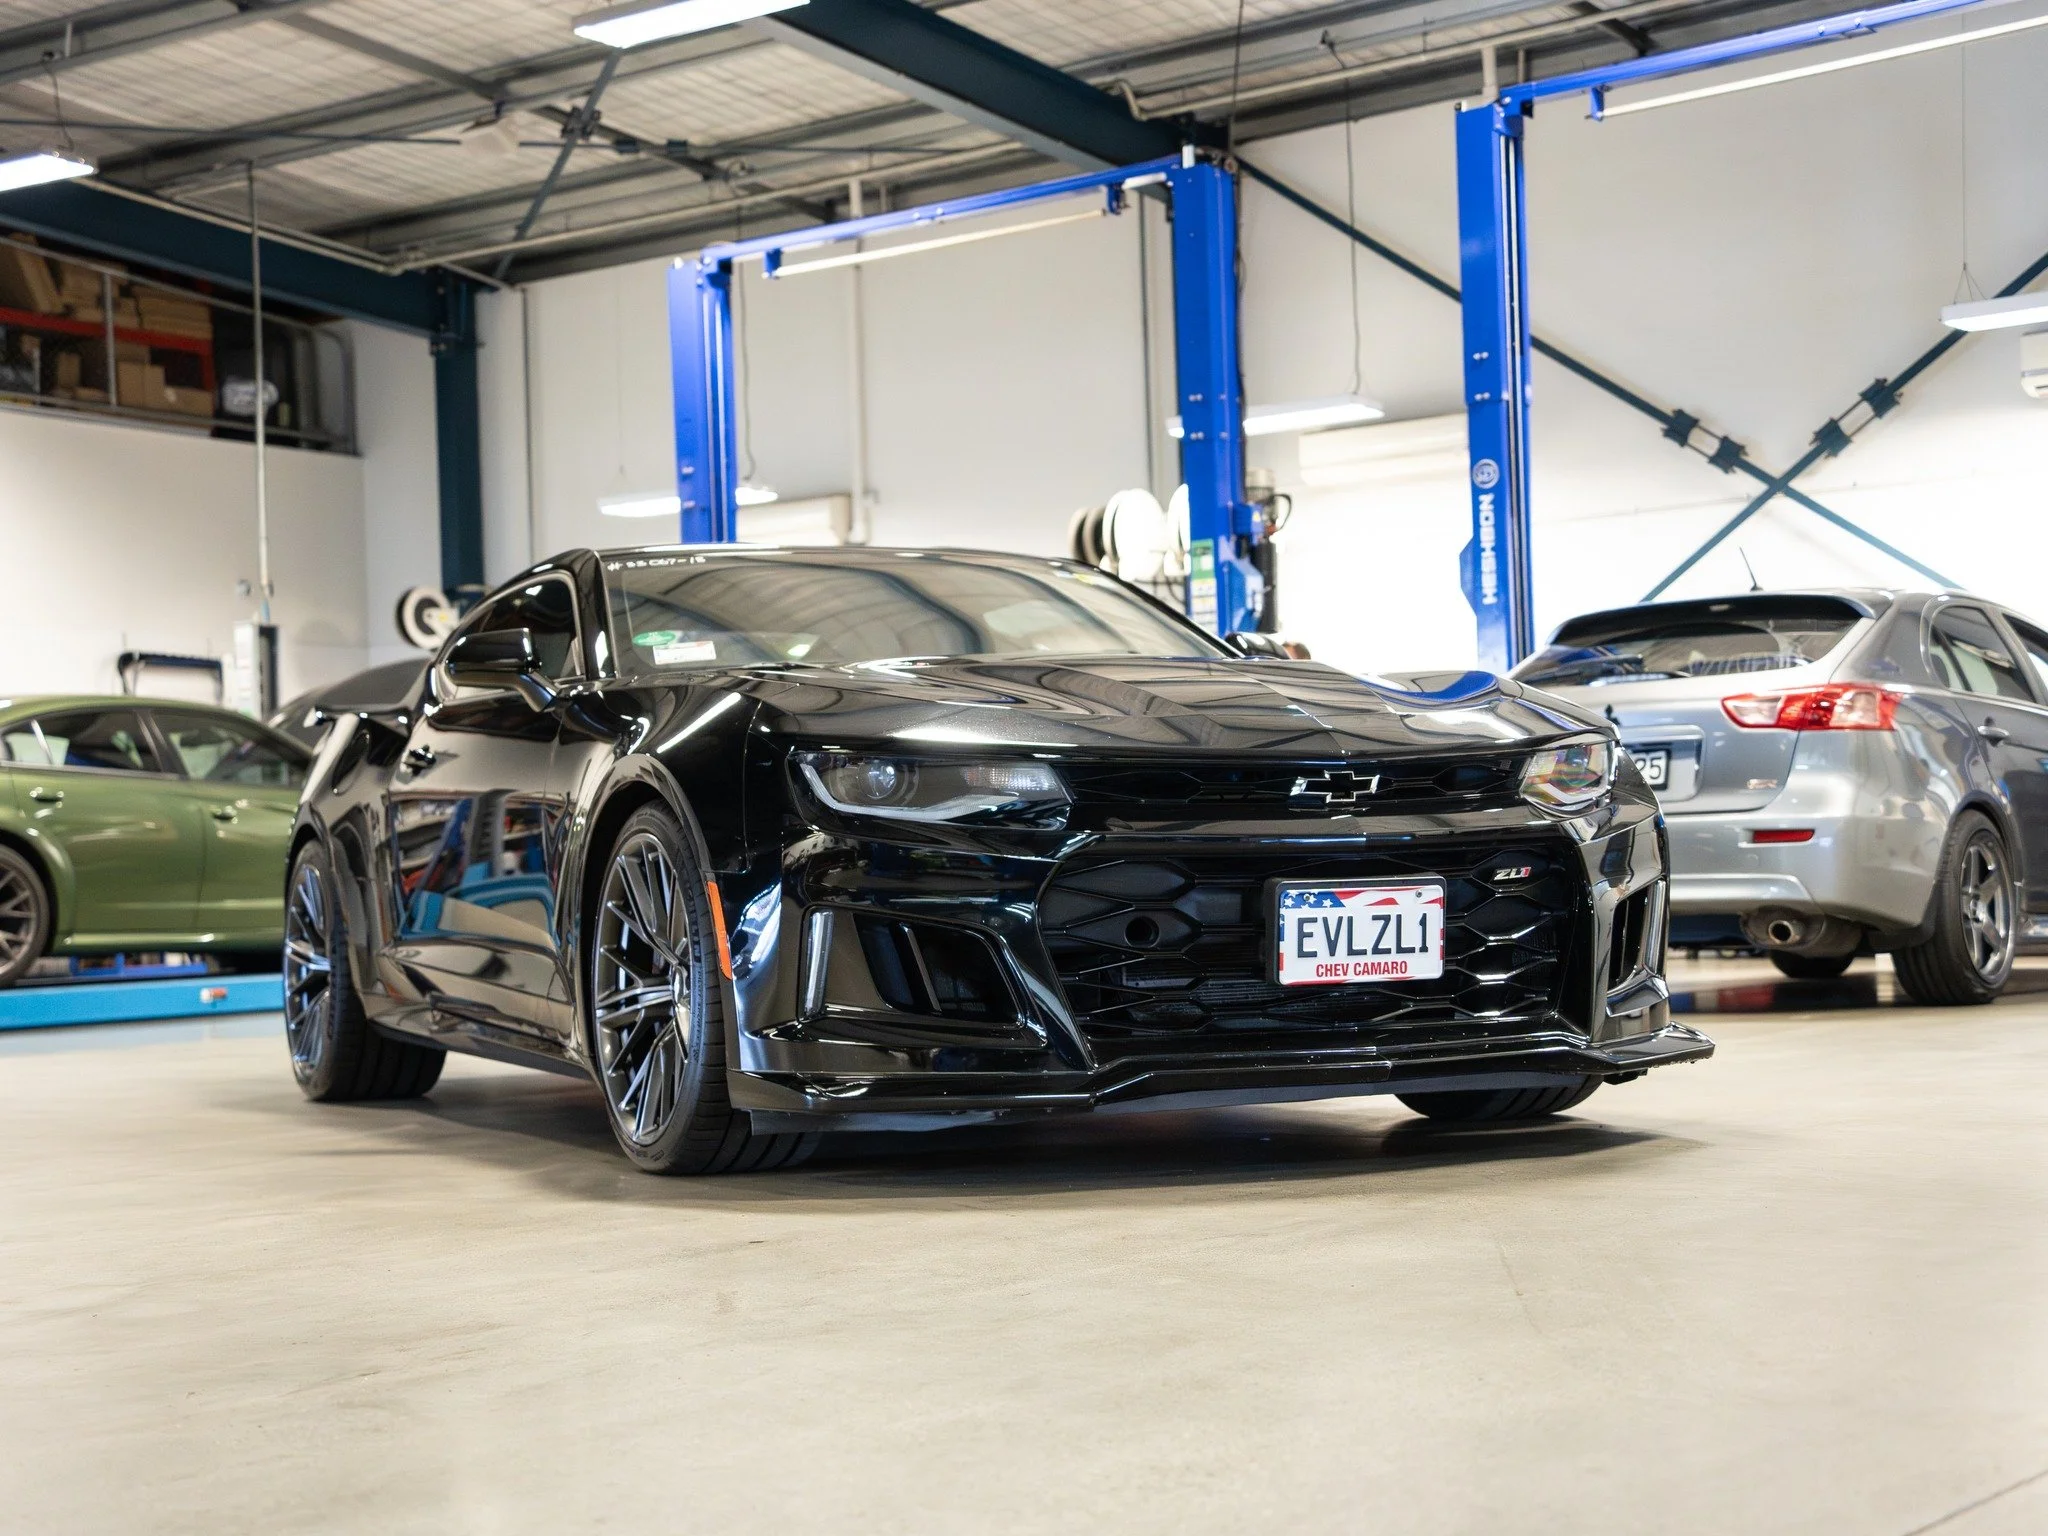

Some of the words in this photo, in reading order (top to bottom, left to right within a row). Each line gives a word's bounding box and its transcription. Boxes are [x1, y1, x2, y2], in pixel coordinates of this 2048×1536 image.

[1494, 867, 1531, 880] ZL1
[1297, 912, 1429, 958] EVLZL1
[1316, 962, 1349, 977] CHEV
[1353, 960, 1408, 976] CAMARO
